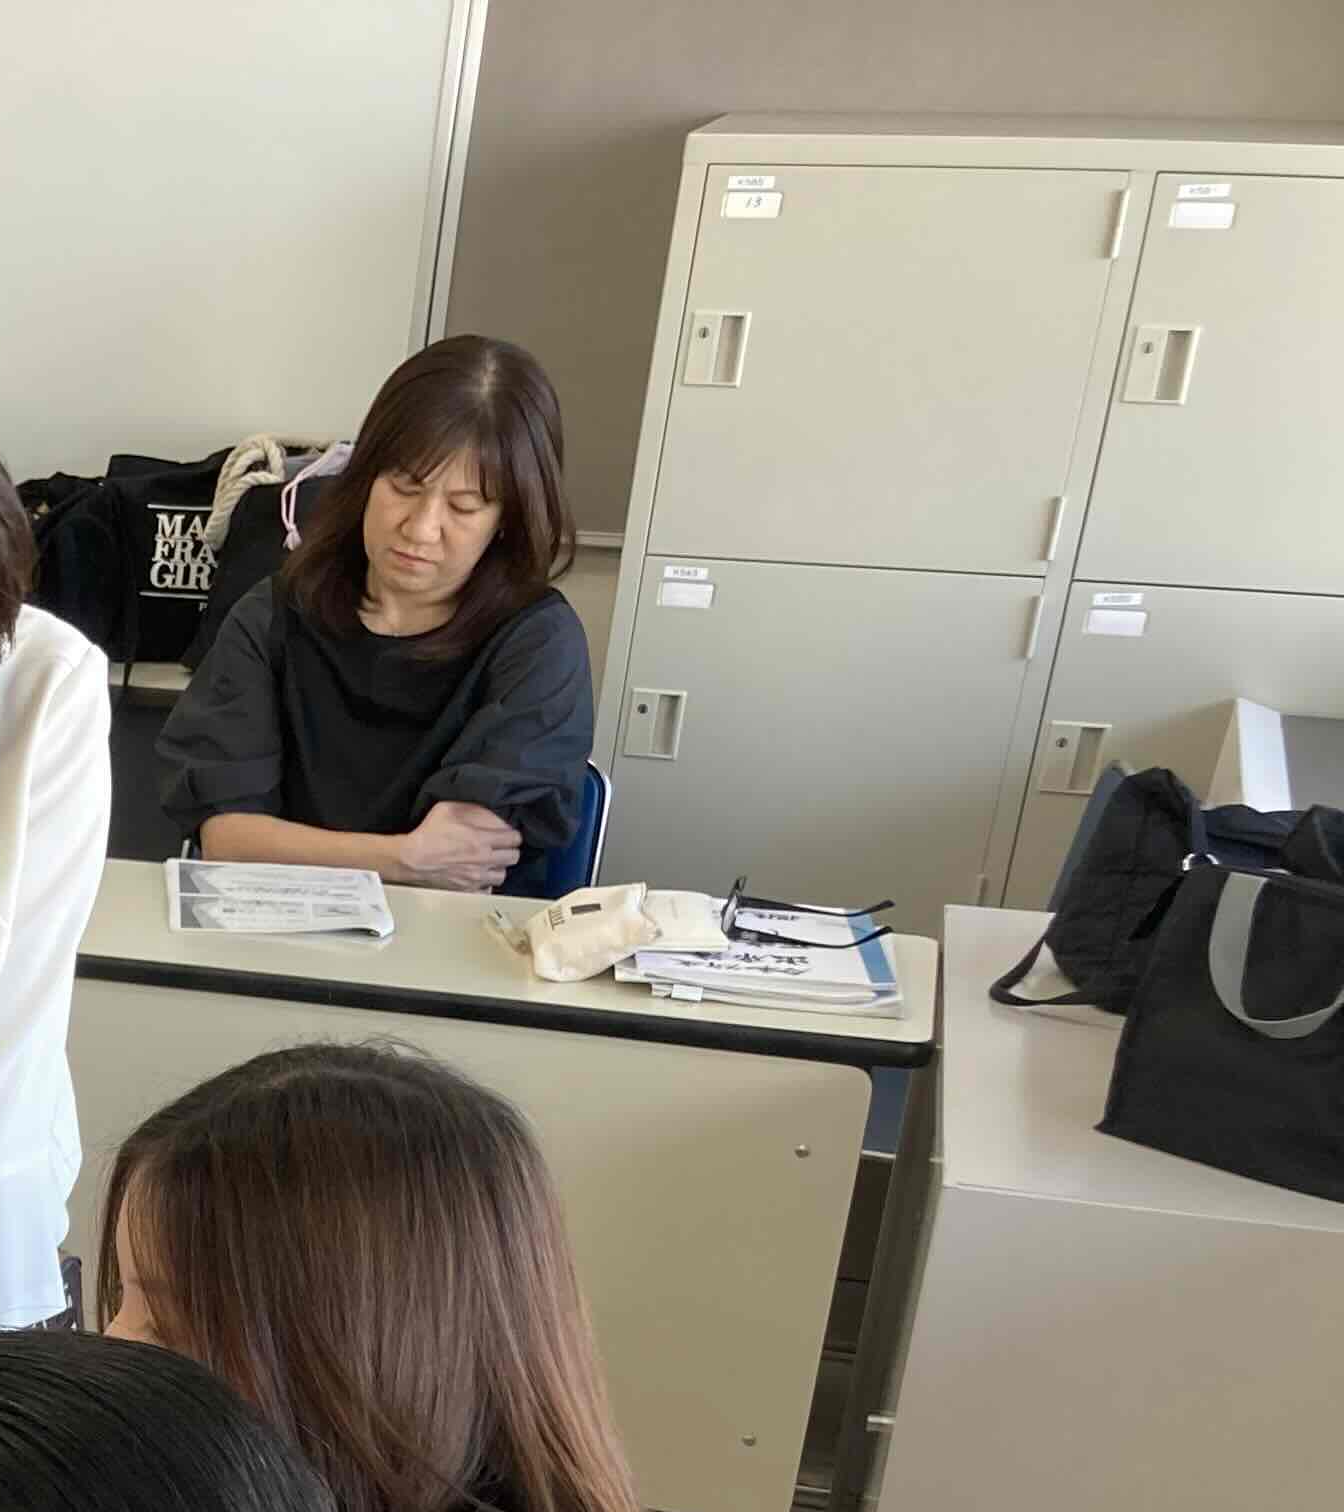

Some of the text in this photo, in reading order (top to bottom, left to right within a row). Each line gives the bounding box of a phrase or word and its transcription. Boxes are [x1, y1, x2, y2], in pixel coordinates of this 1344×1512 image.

[156, 513, 210, 540] MA
[152, 539, 218, 568] FRA
[150, 560, 212, 590] GIR
